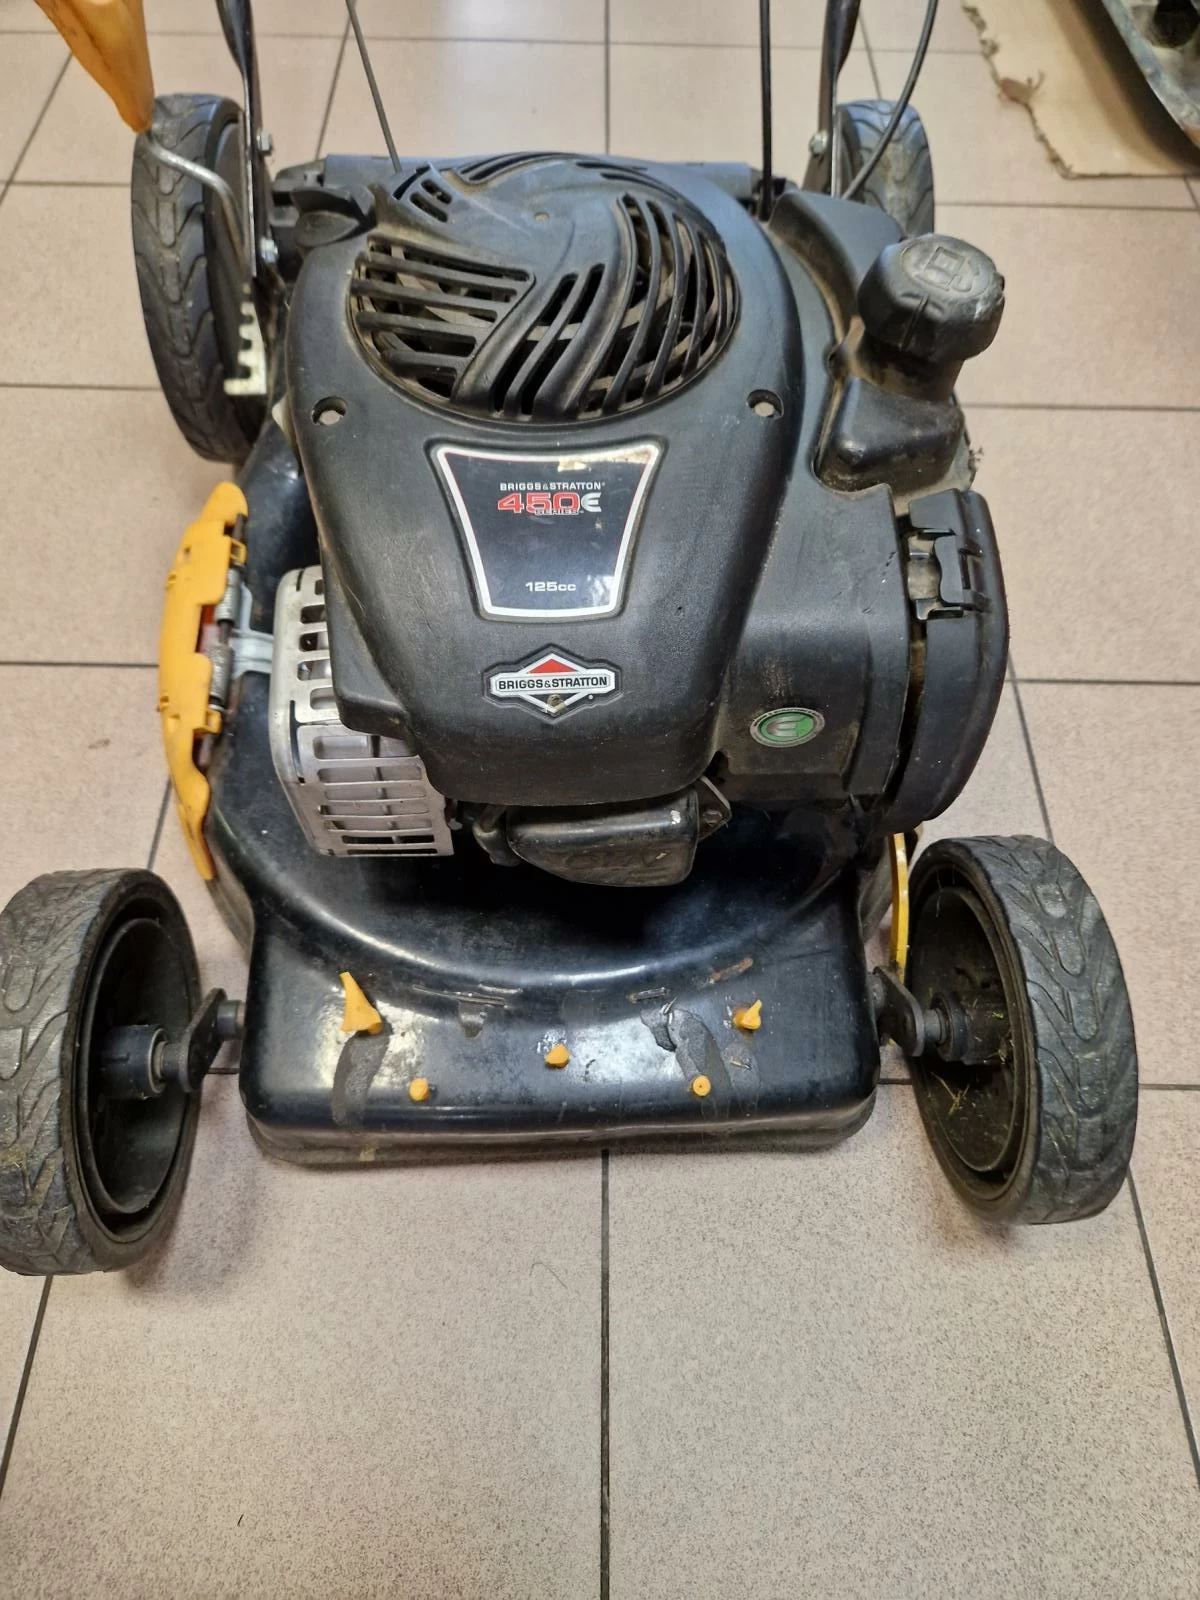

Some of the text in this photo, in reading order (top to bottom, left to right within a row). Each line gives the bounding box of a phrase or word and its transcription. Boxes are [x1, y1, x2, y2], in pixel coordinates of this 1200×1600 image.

[497, 492, 602, 514] 450E
[525, 581, 577, 592] 125cc
[498, 676, 608, 690] BRIGGS&STRATTON
